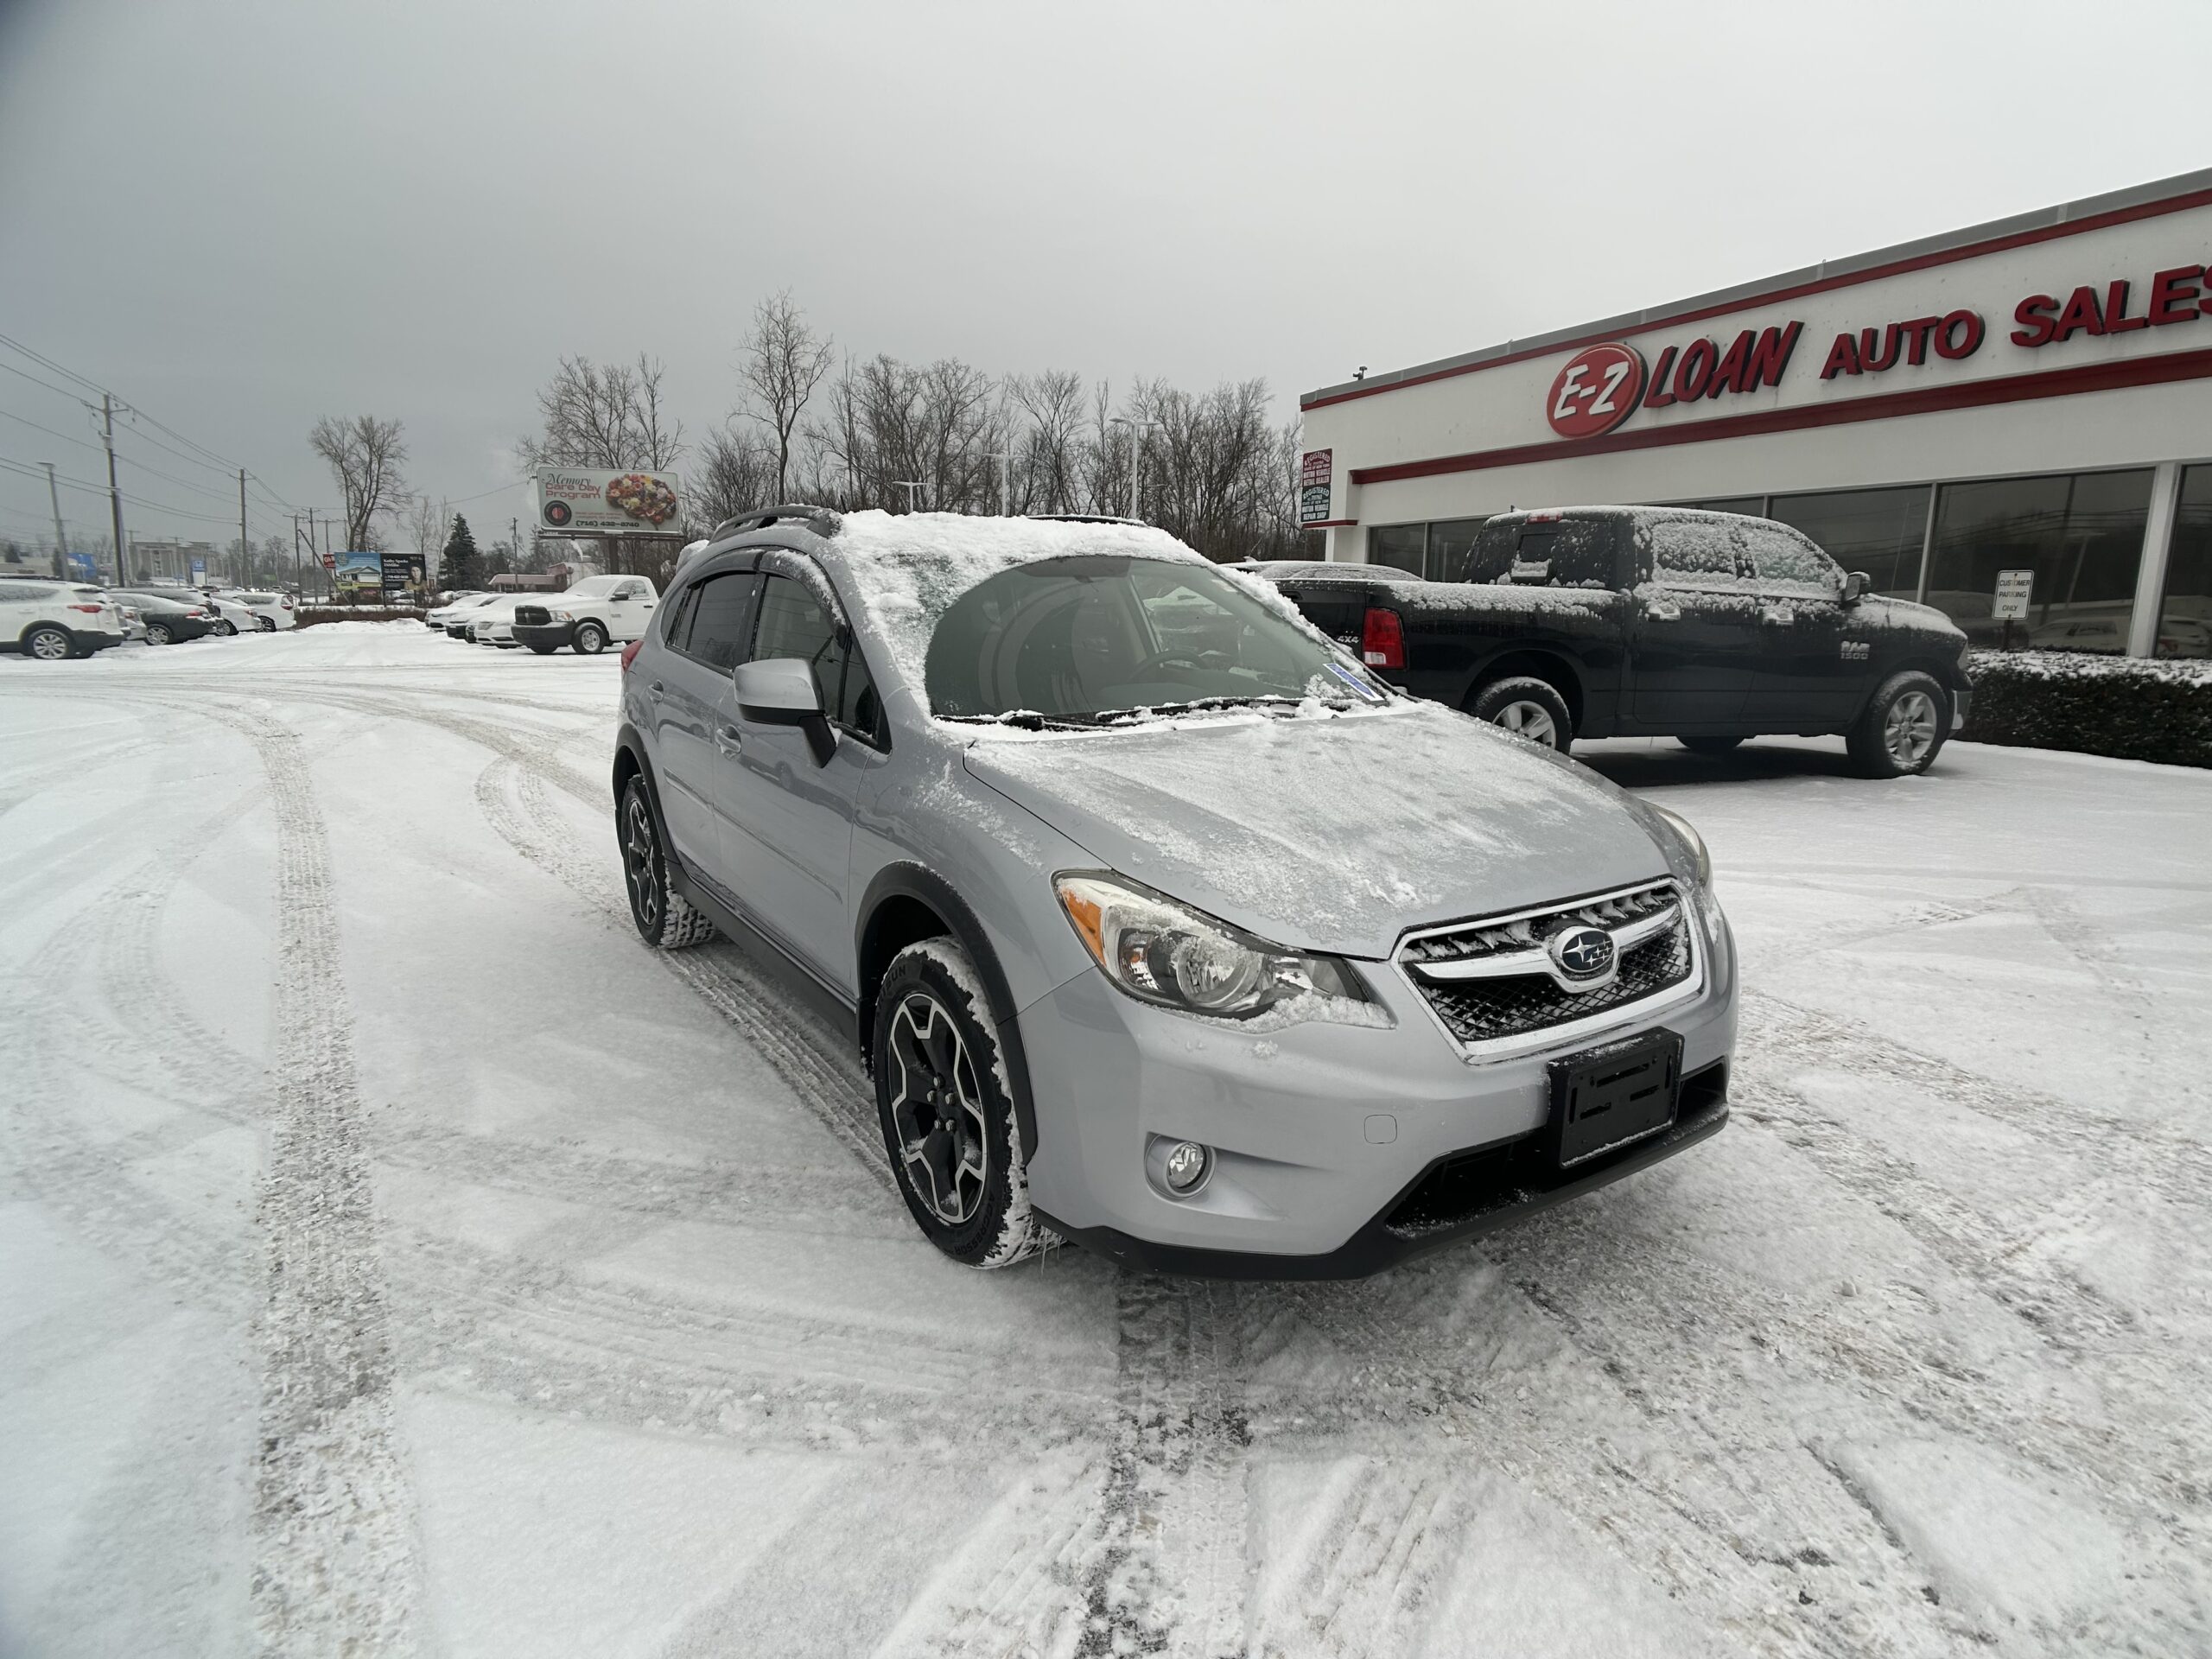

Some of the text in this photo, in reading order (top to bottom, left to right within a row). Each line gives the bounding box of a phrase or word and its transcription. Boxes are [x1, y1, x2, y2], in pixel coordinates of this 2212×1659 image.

[1554, 264, 2212, 420] E-Z LOAN AUTO SALE
[1304, 452, 1330, 466] REGISTERED
[1316, 467, 1330, 476] VEHICLE
[542, 473, 592, 486] Memory
[1316, 475, 1330, 484] DEALER
[578, 484, 601, 493] Day
[1303, 486, 1329, 499] REGISTERED
[545, 490, 601, 500] Program
[1314, 503, 1329, 512] VEHICLE
[1841, 640, 1870, 652] RAM
